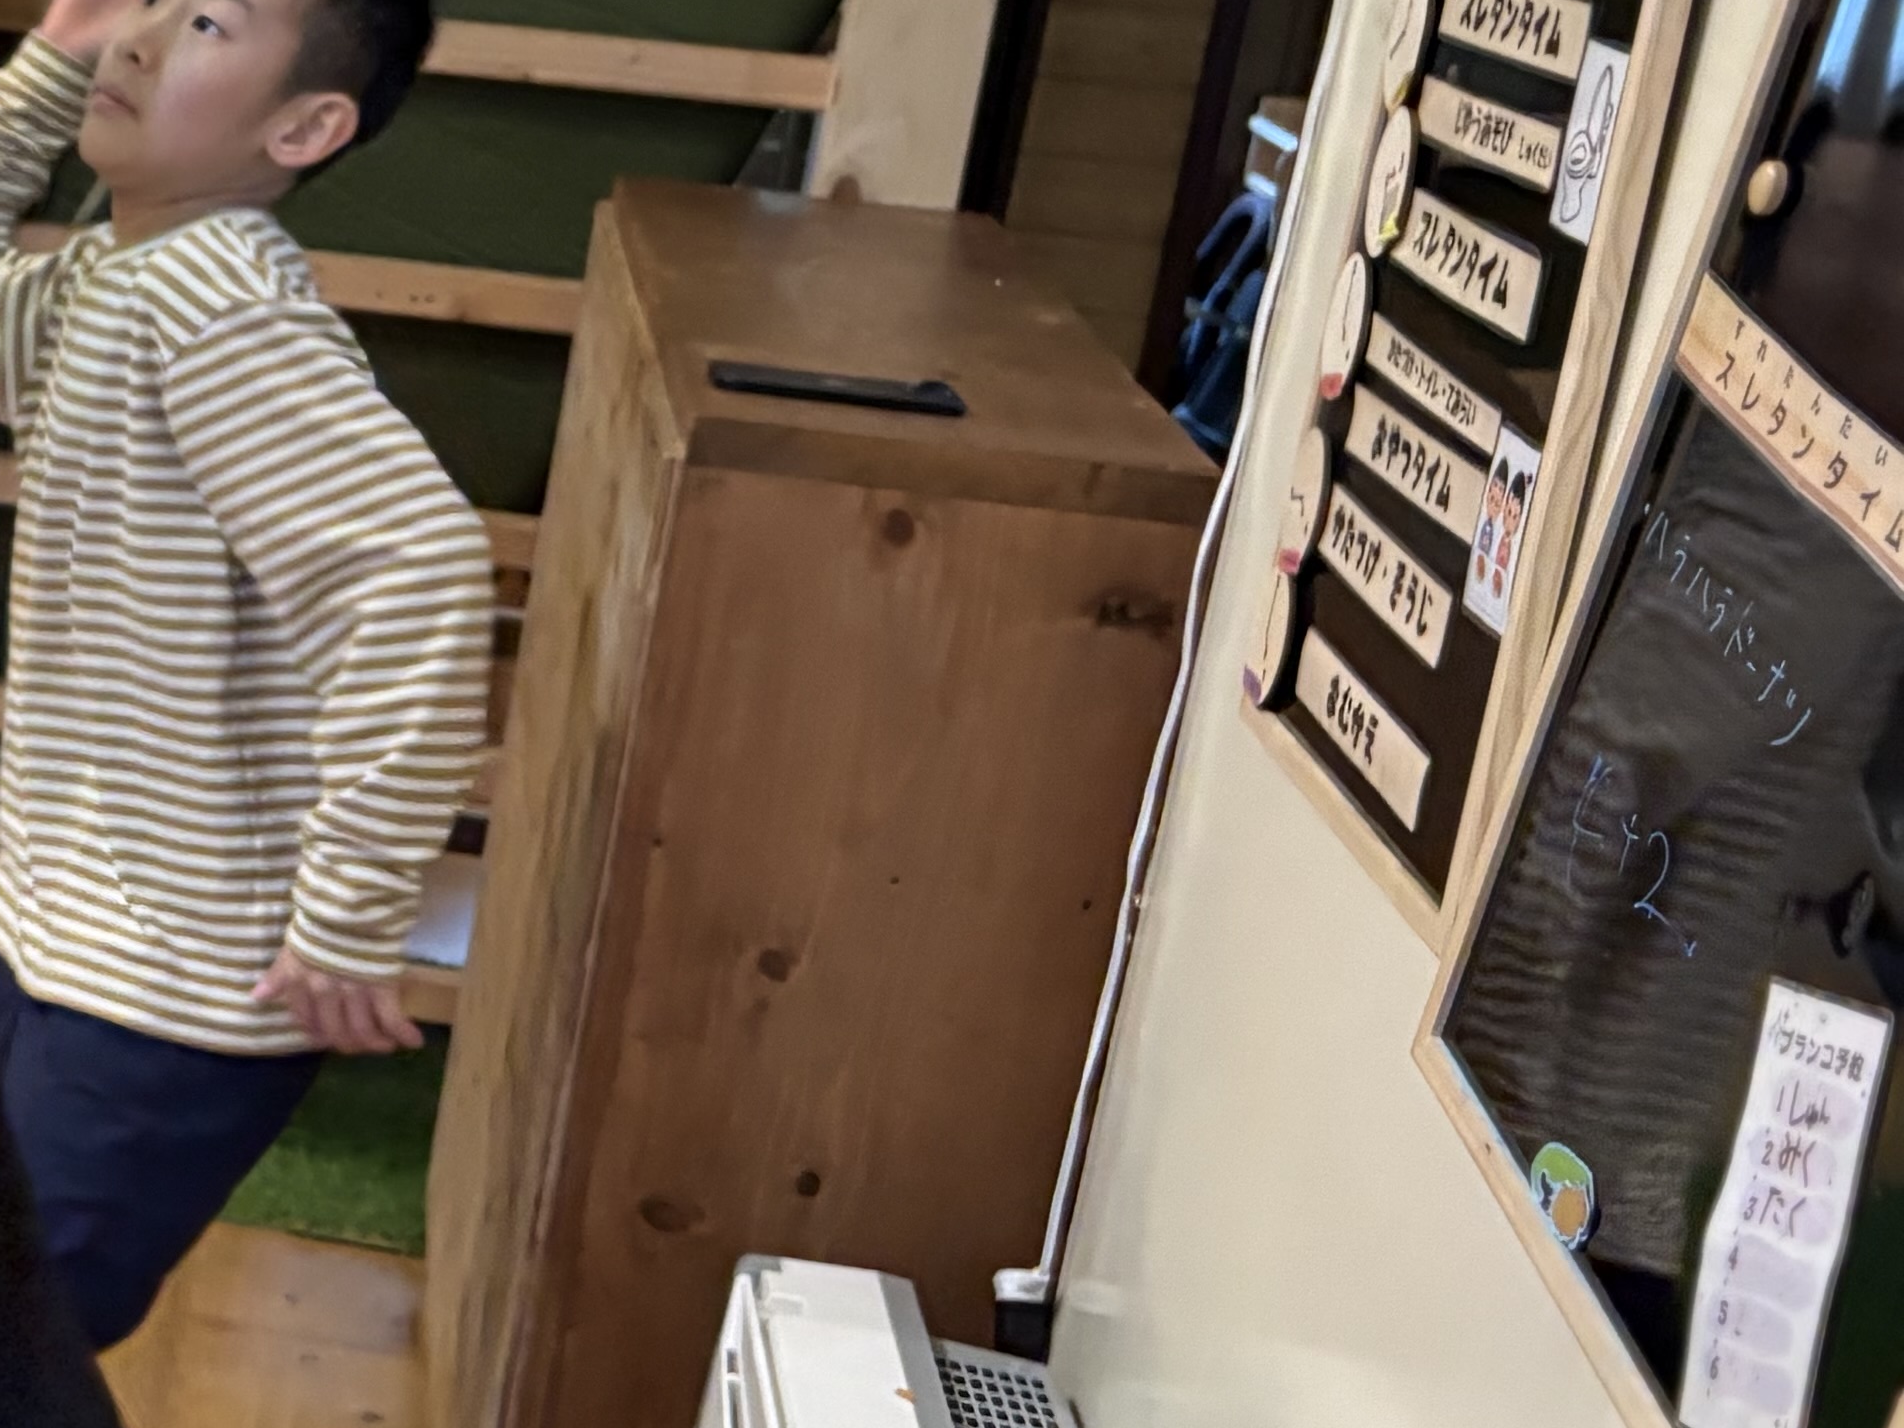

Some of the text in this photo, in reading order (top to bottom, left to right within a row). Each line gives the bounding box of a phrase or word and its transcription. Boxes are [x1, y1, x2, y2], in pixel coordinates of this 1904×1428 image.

[1413, 210, 1508, 310] スレタンタイム
[1371, 414, 1451, 513] おやつタイム
[1715, 350, 1904, 553] スレタンタイム
[1326, 673, 1380, 767] おむかえ
[1761, 1140, 1774, 1167] 2
[1743, 1195, 1758, 1222] 3
[1728, 1245, 1739, 1271] 4
[1718, 1299, 1729, 1326] 5
[1710, 1355, 1720, 1381] 6
